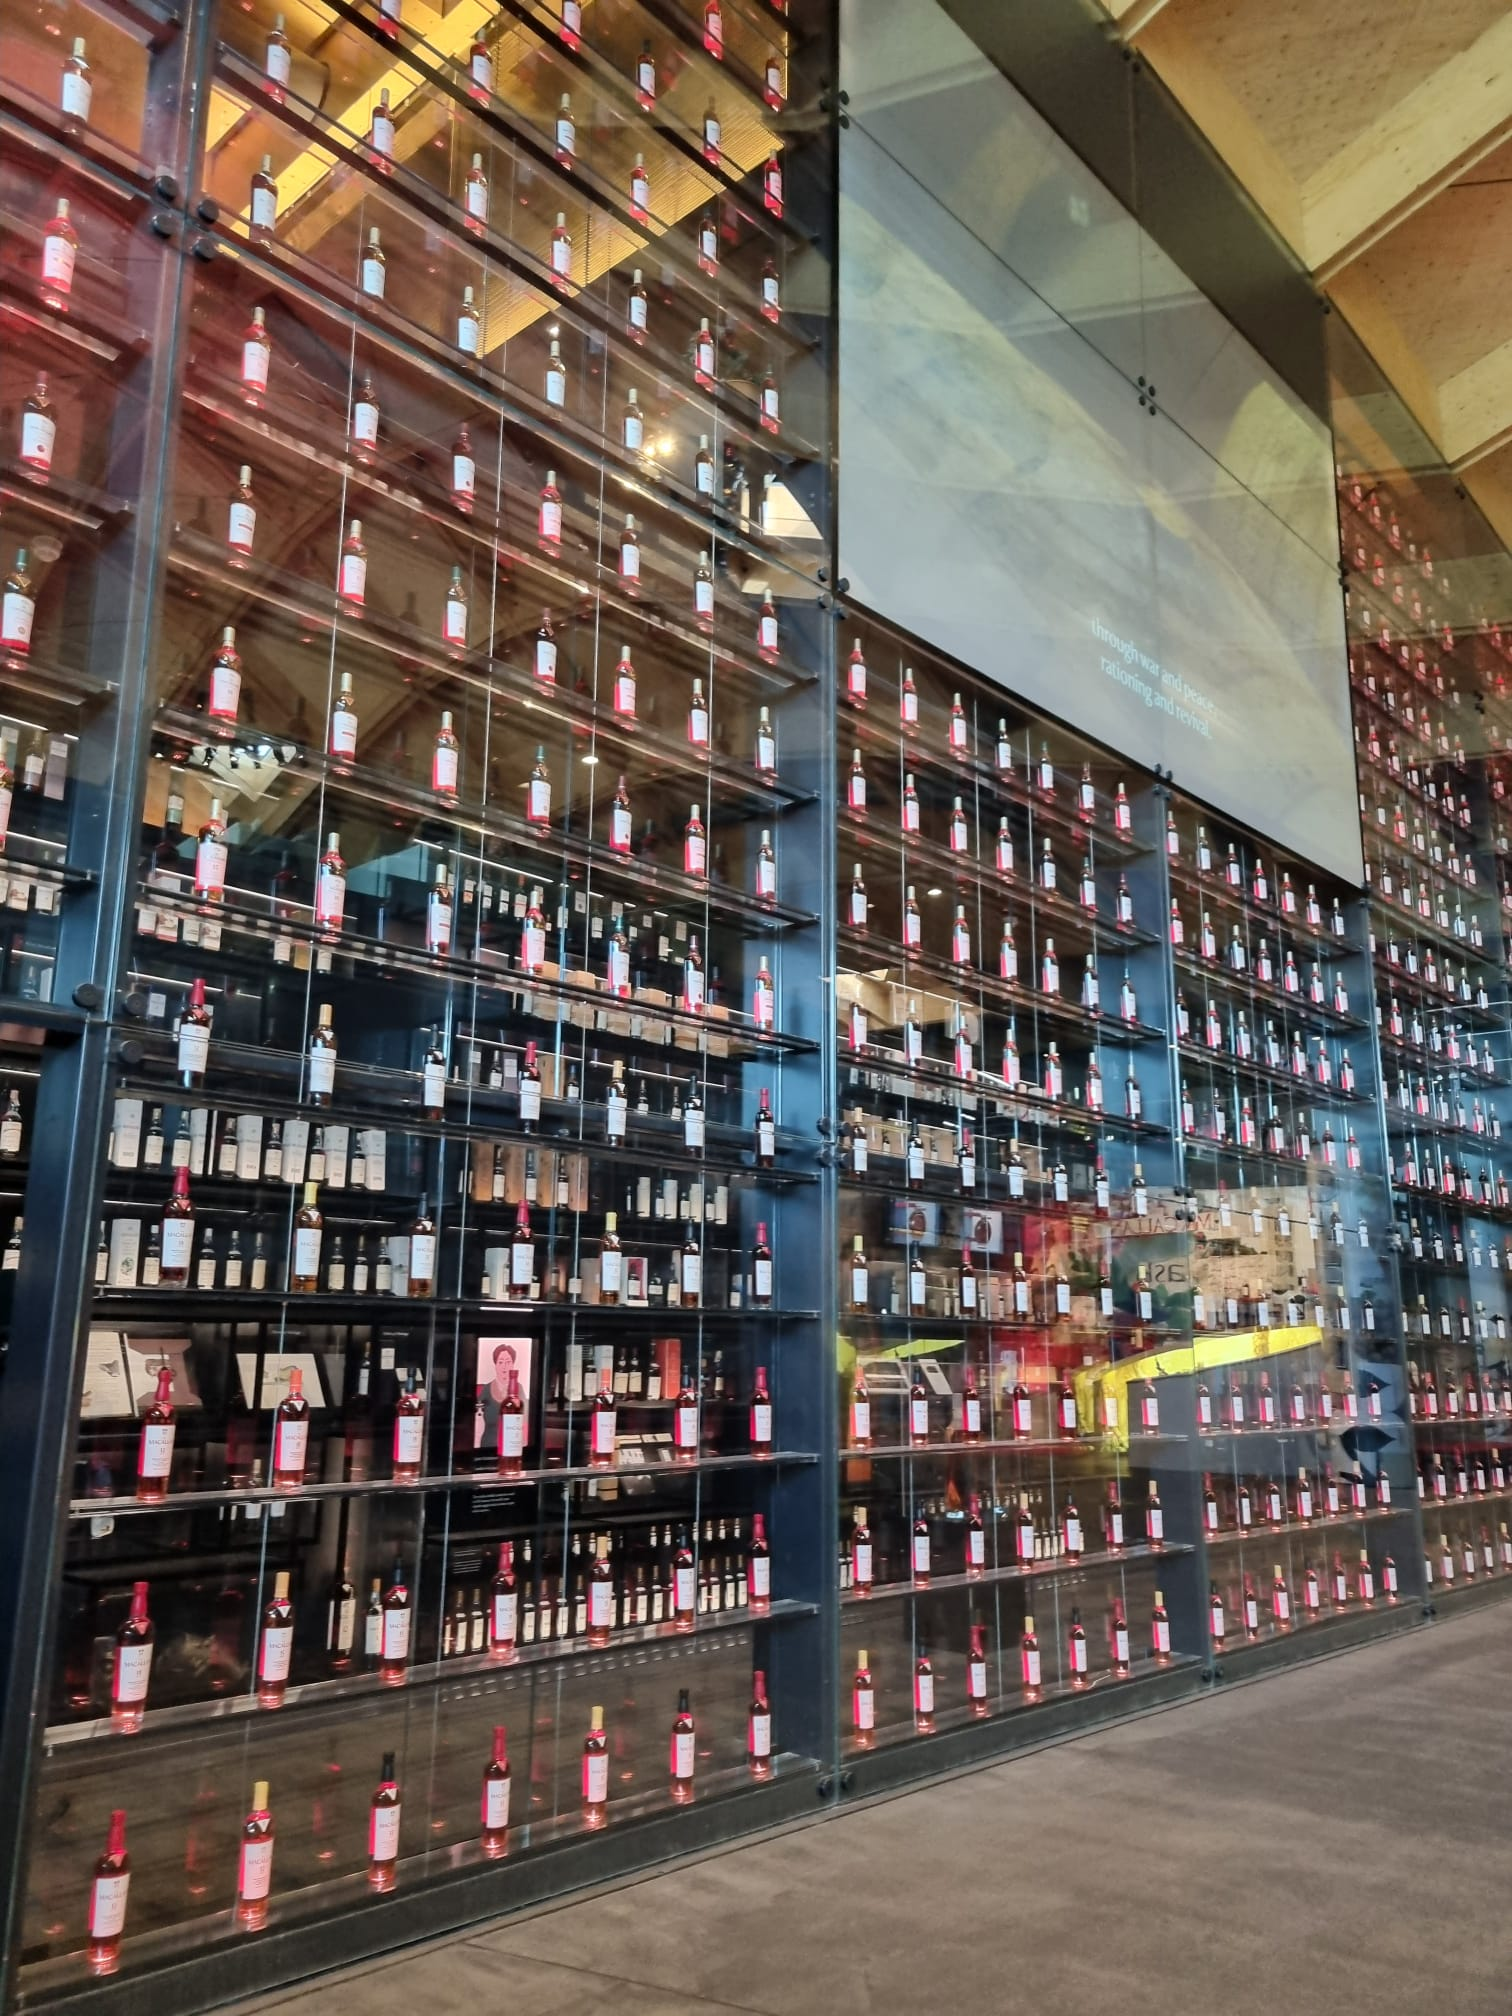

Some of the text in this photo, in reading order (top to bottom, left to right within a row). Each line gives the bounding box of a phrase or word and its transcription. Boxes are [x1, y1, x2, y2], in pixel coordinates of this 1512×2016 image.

[1091, 617, 1139, 664] through
[1139, 653, 1160, 677] war
[1161, 669, 1182, 693] and
[1100, 656, 1153, 707] rationing
[1153, 692, 1174, 716] and
